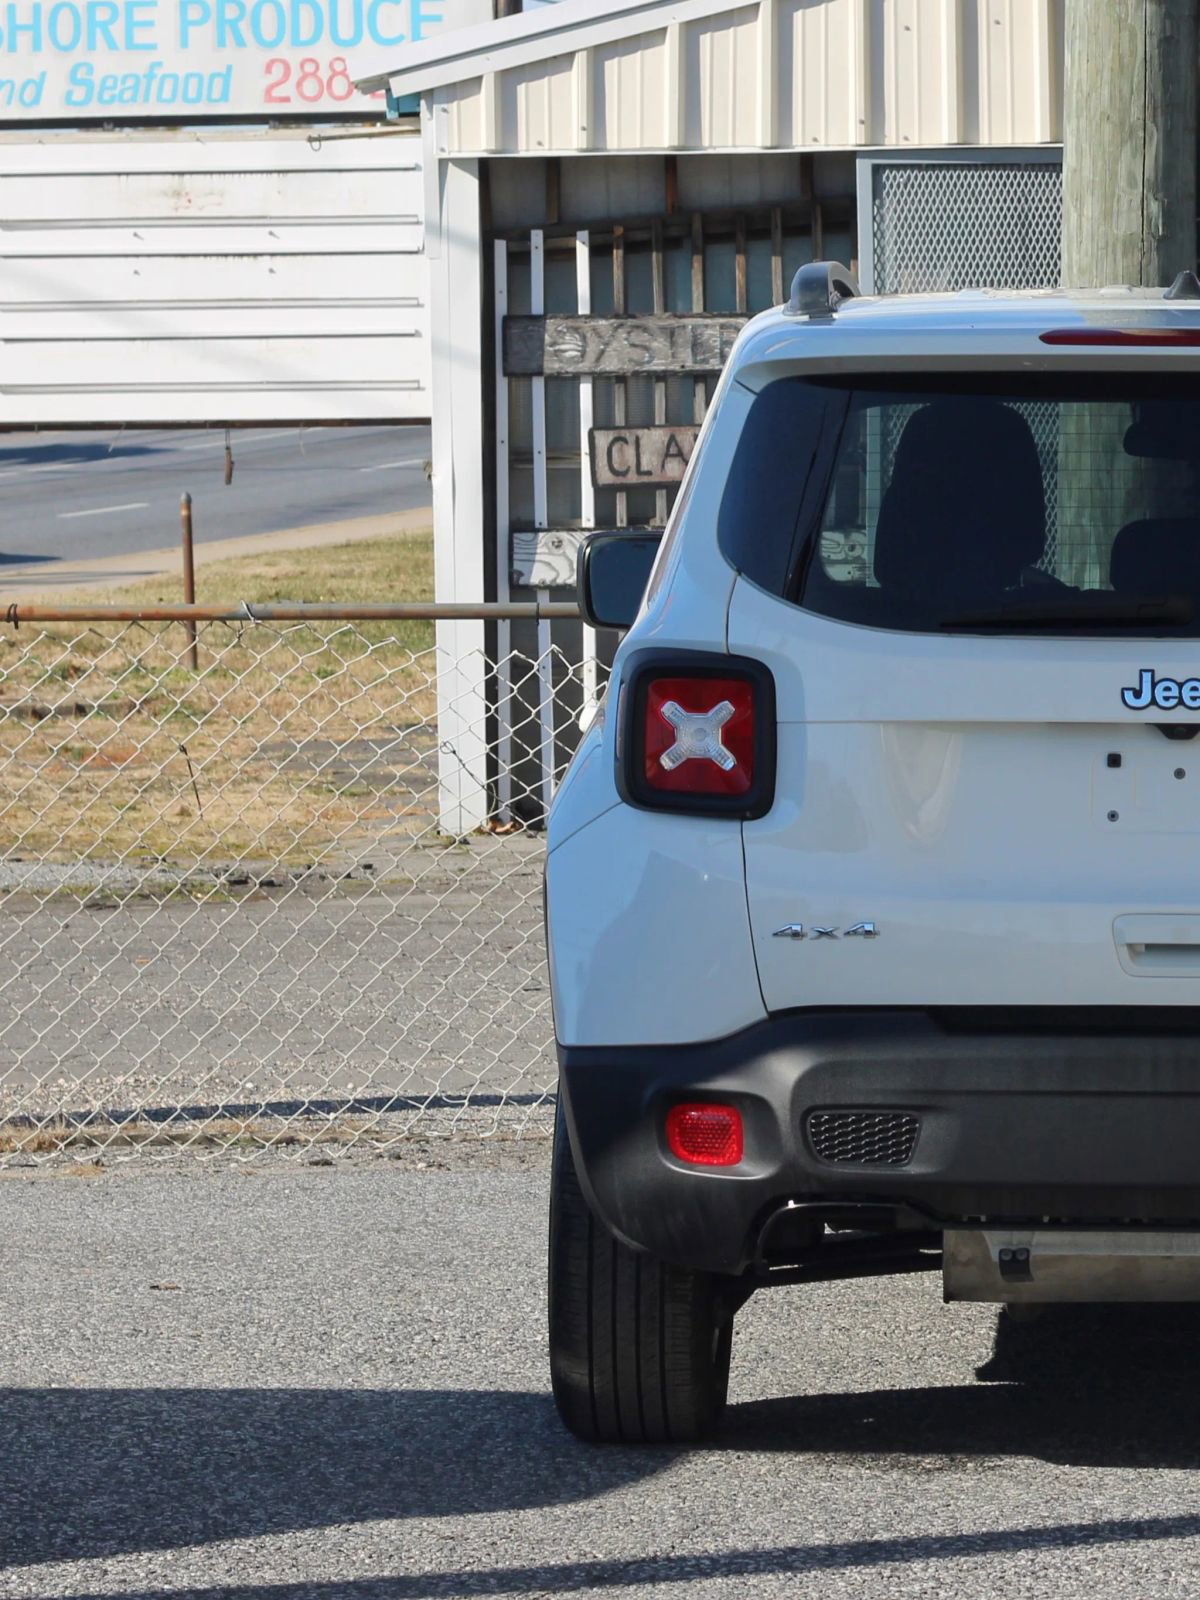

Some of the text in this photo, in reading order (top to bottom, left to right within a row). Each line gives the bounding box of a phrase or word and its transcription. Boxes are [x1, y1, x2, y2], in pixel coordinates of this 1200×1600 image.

[0, 0, 447, 53] HORE PRODUCE
[64, 61, 234, 107] Seafood
[606, 432, 699, 477] CLA
